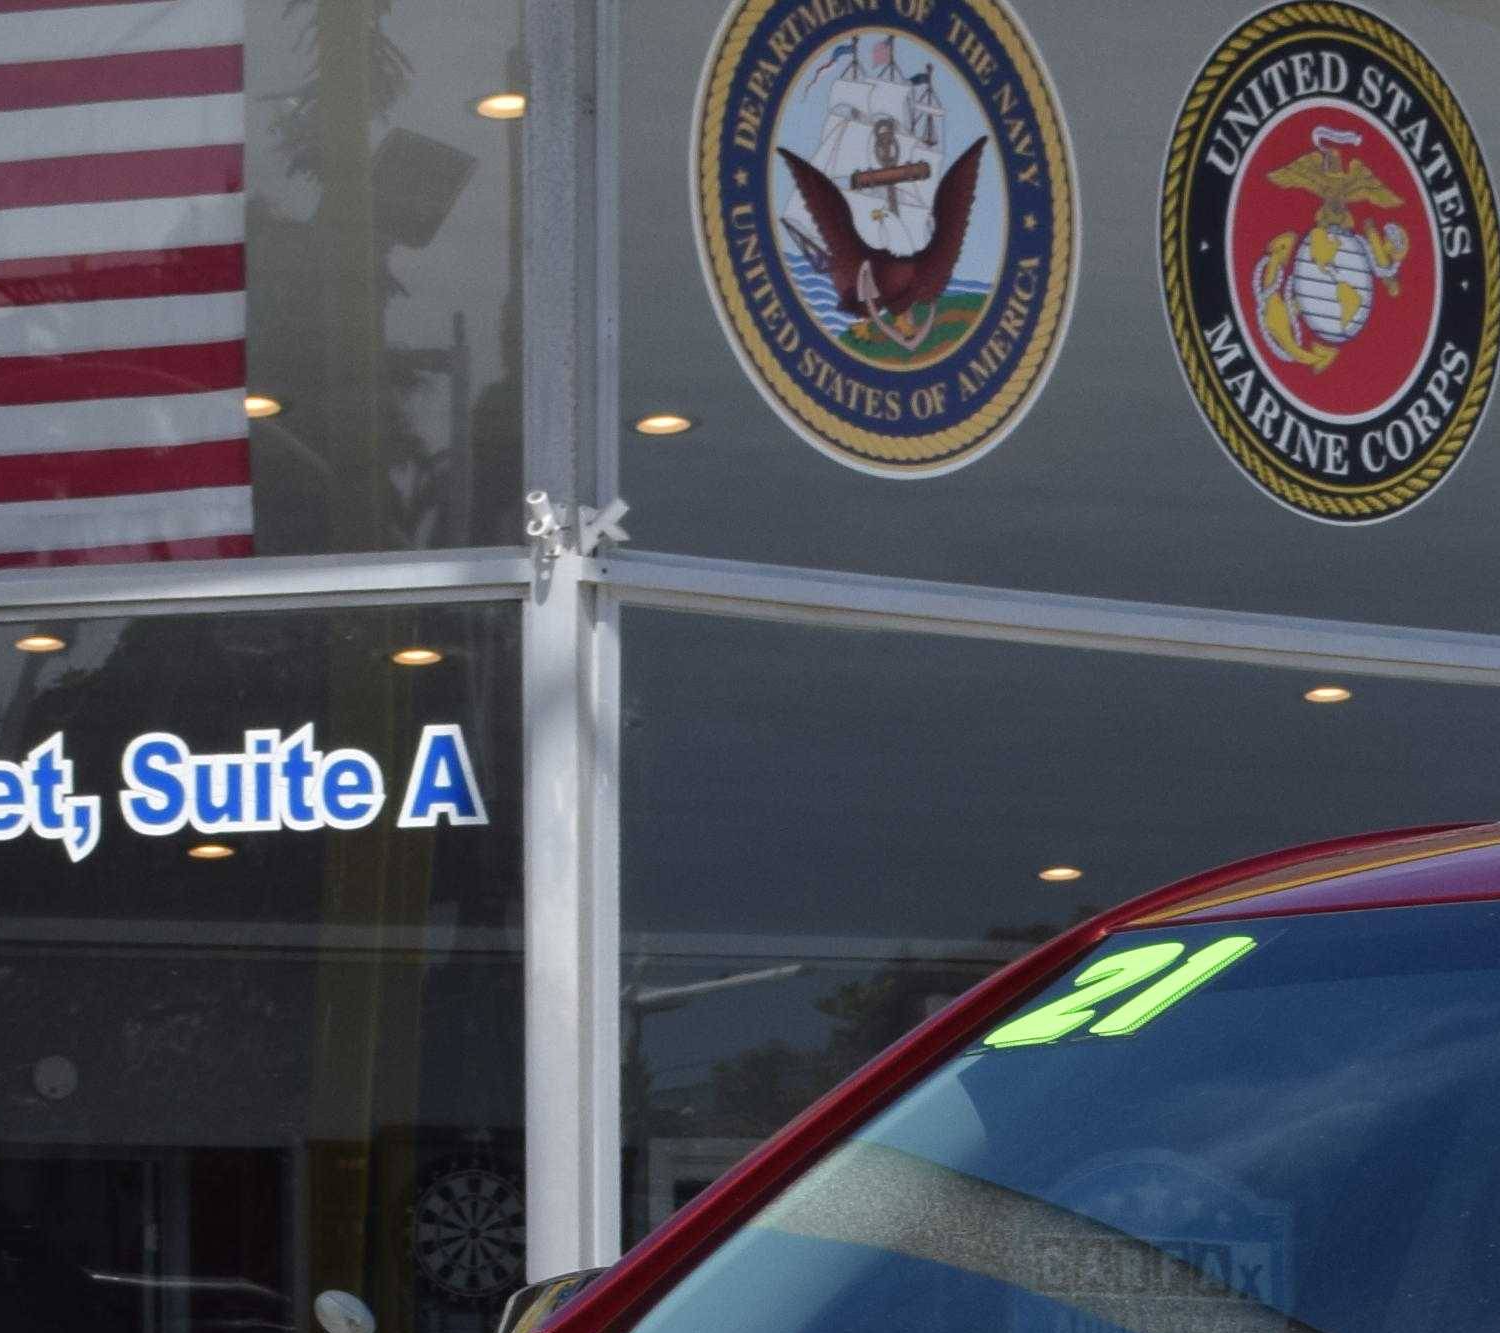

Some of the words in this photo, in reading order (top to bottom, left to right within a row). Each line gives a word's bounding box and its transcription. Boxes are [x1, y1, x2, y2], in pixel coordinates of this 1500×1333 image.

[895, 0, 935, 23] OF
[948, 12, 998, 86] THE
[993, 83, 1042, 188] NAVY
[1204, 51, 1349, 177] UNITED
[1357, 64, 1472, 259] STATES
[731, 201, 800, 354] UNITED
[797, 347, 903, 421] STATES
[909, 382, 948, 421] OF
[957, 255, 1041, 402] AMERICA
[1204, 315, 1350, 476] MARINE
[1359, 340, 1471, 474] CORPS
[118, 722, 387, 833] Suite
[397, 722, 489, 831] A
[982, 935, 1259, 1050] 21
